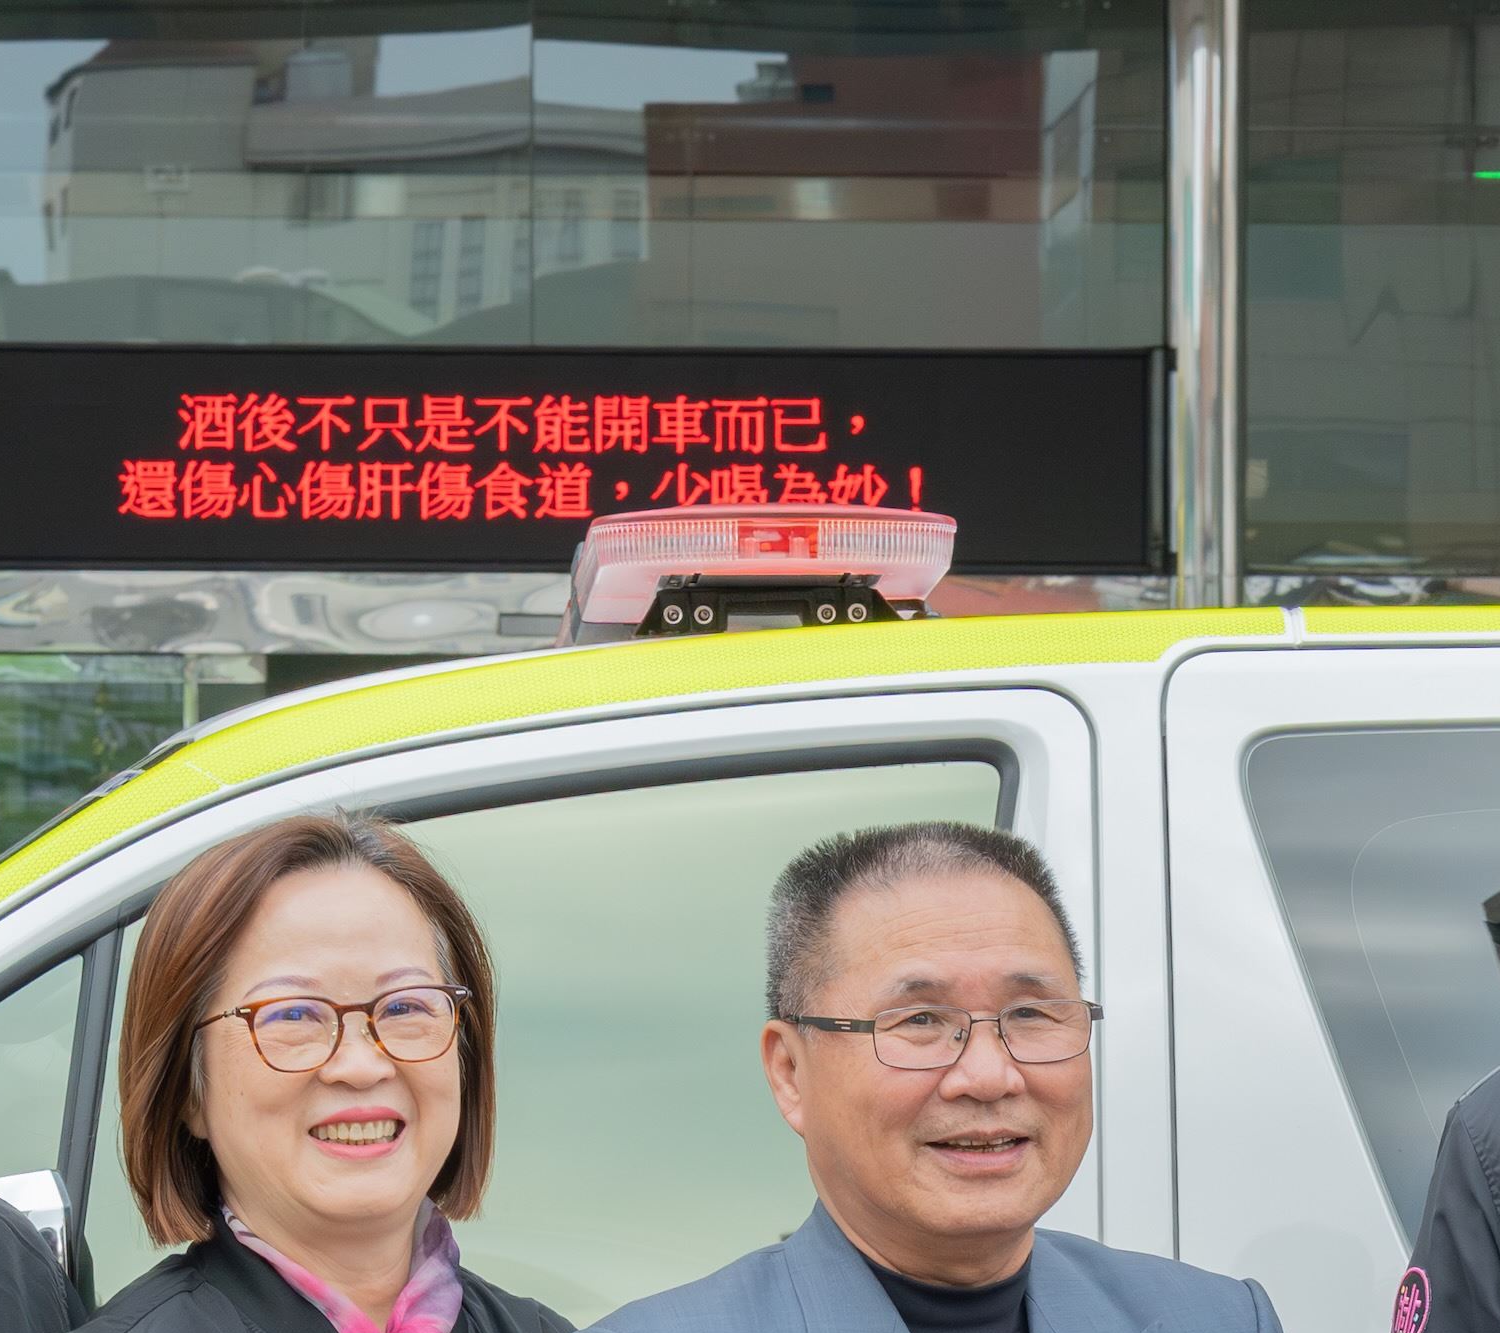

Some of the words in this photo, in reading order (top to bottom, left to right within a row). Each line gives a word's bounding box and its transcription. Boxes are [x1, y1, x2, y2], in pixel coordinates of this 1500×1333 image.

[177, 393, 868, 455] 酒後不只是不能開車而已，
